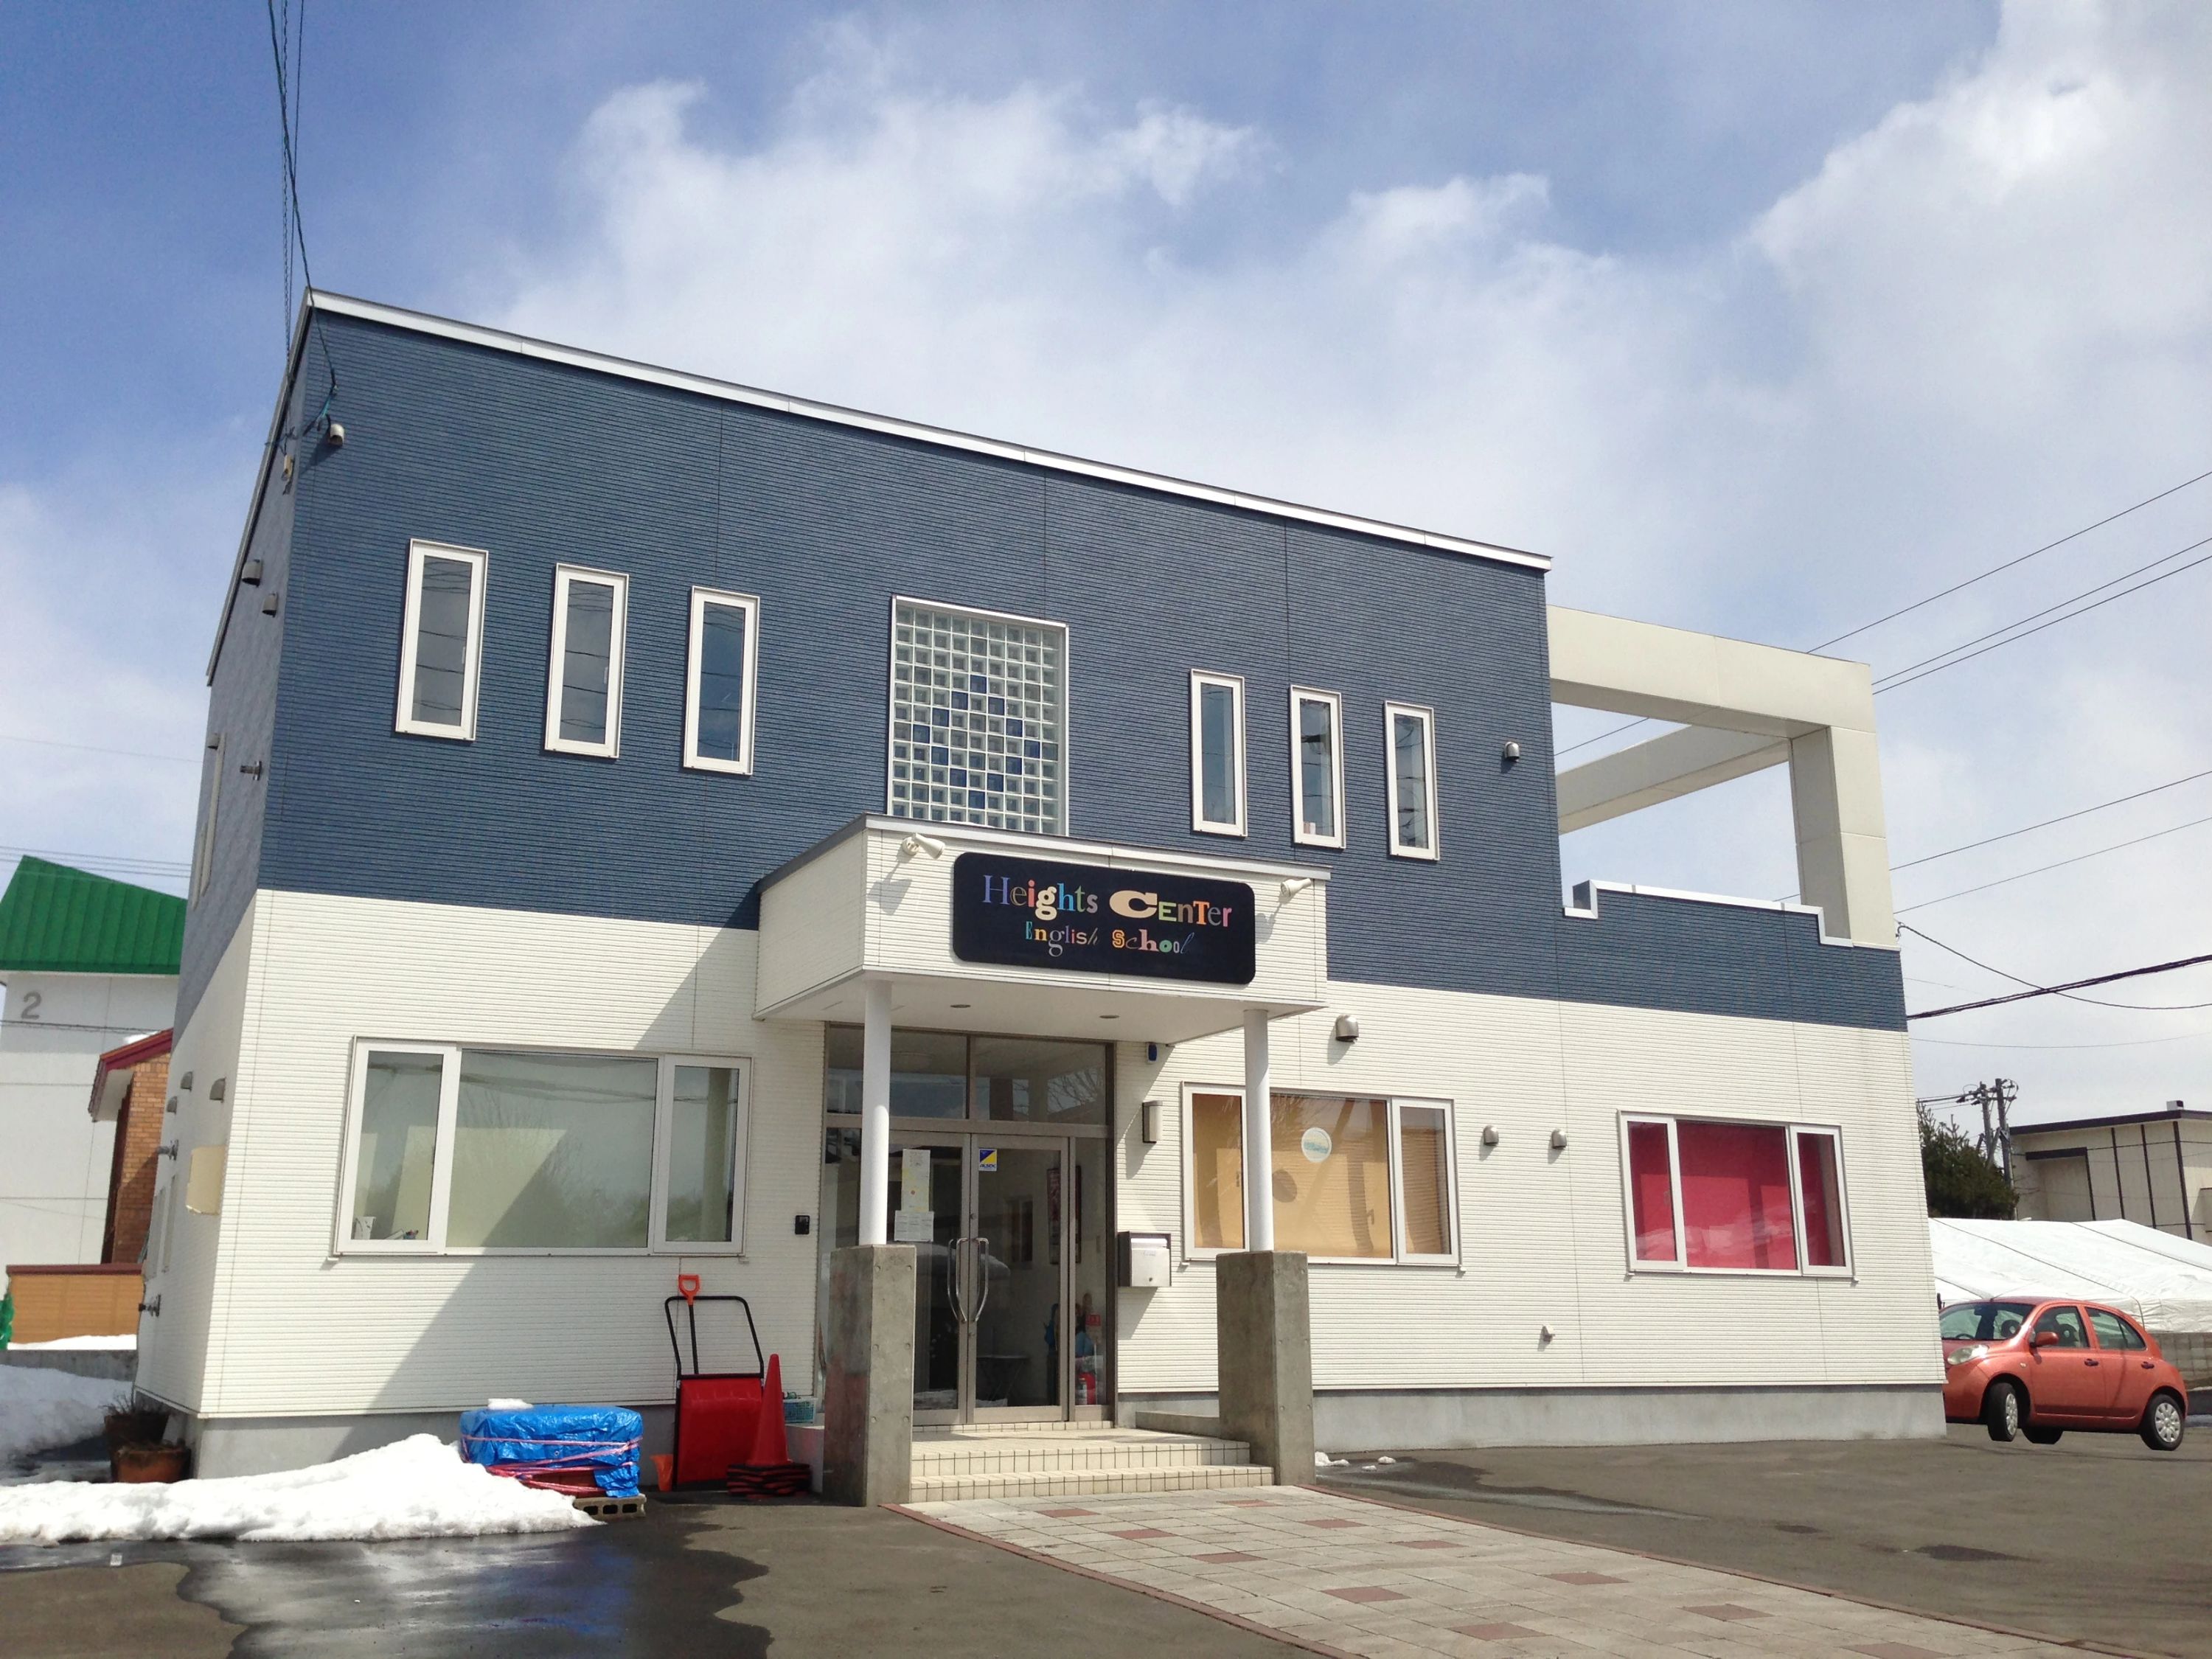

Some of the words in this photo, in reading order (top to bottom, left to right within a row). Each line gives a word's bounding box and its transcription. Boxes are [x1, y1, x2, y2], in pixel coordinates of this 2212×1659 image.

[983, 874, 1098, 921] Heights
[1026, 921, 1099, 957] English
[1112, 929, 1194, 953] School
[21, 992, 41, 1019] 2
